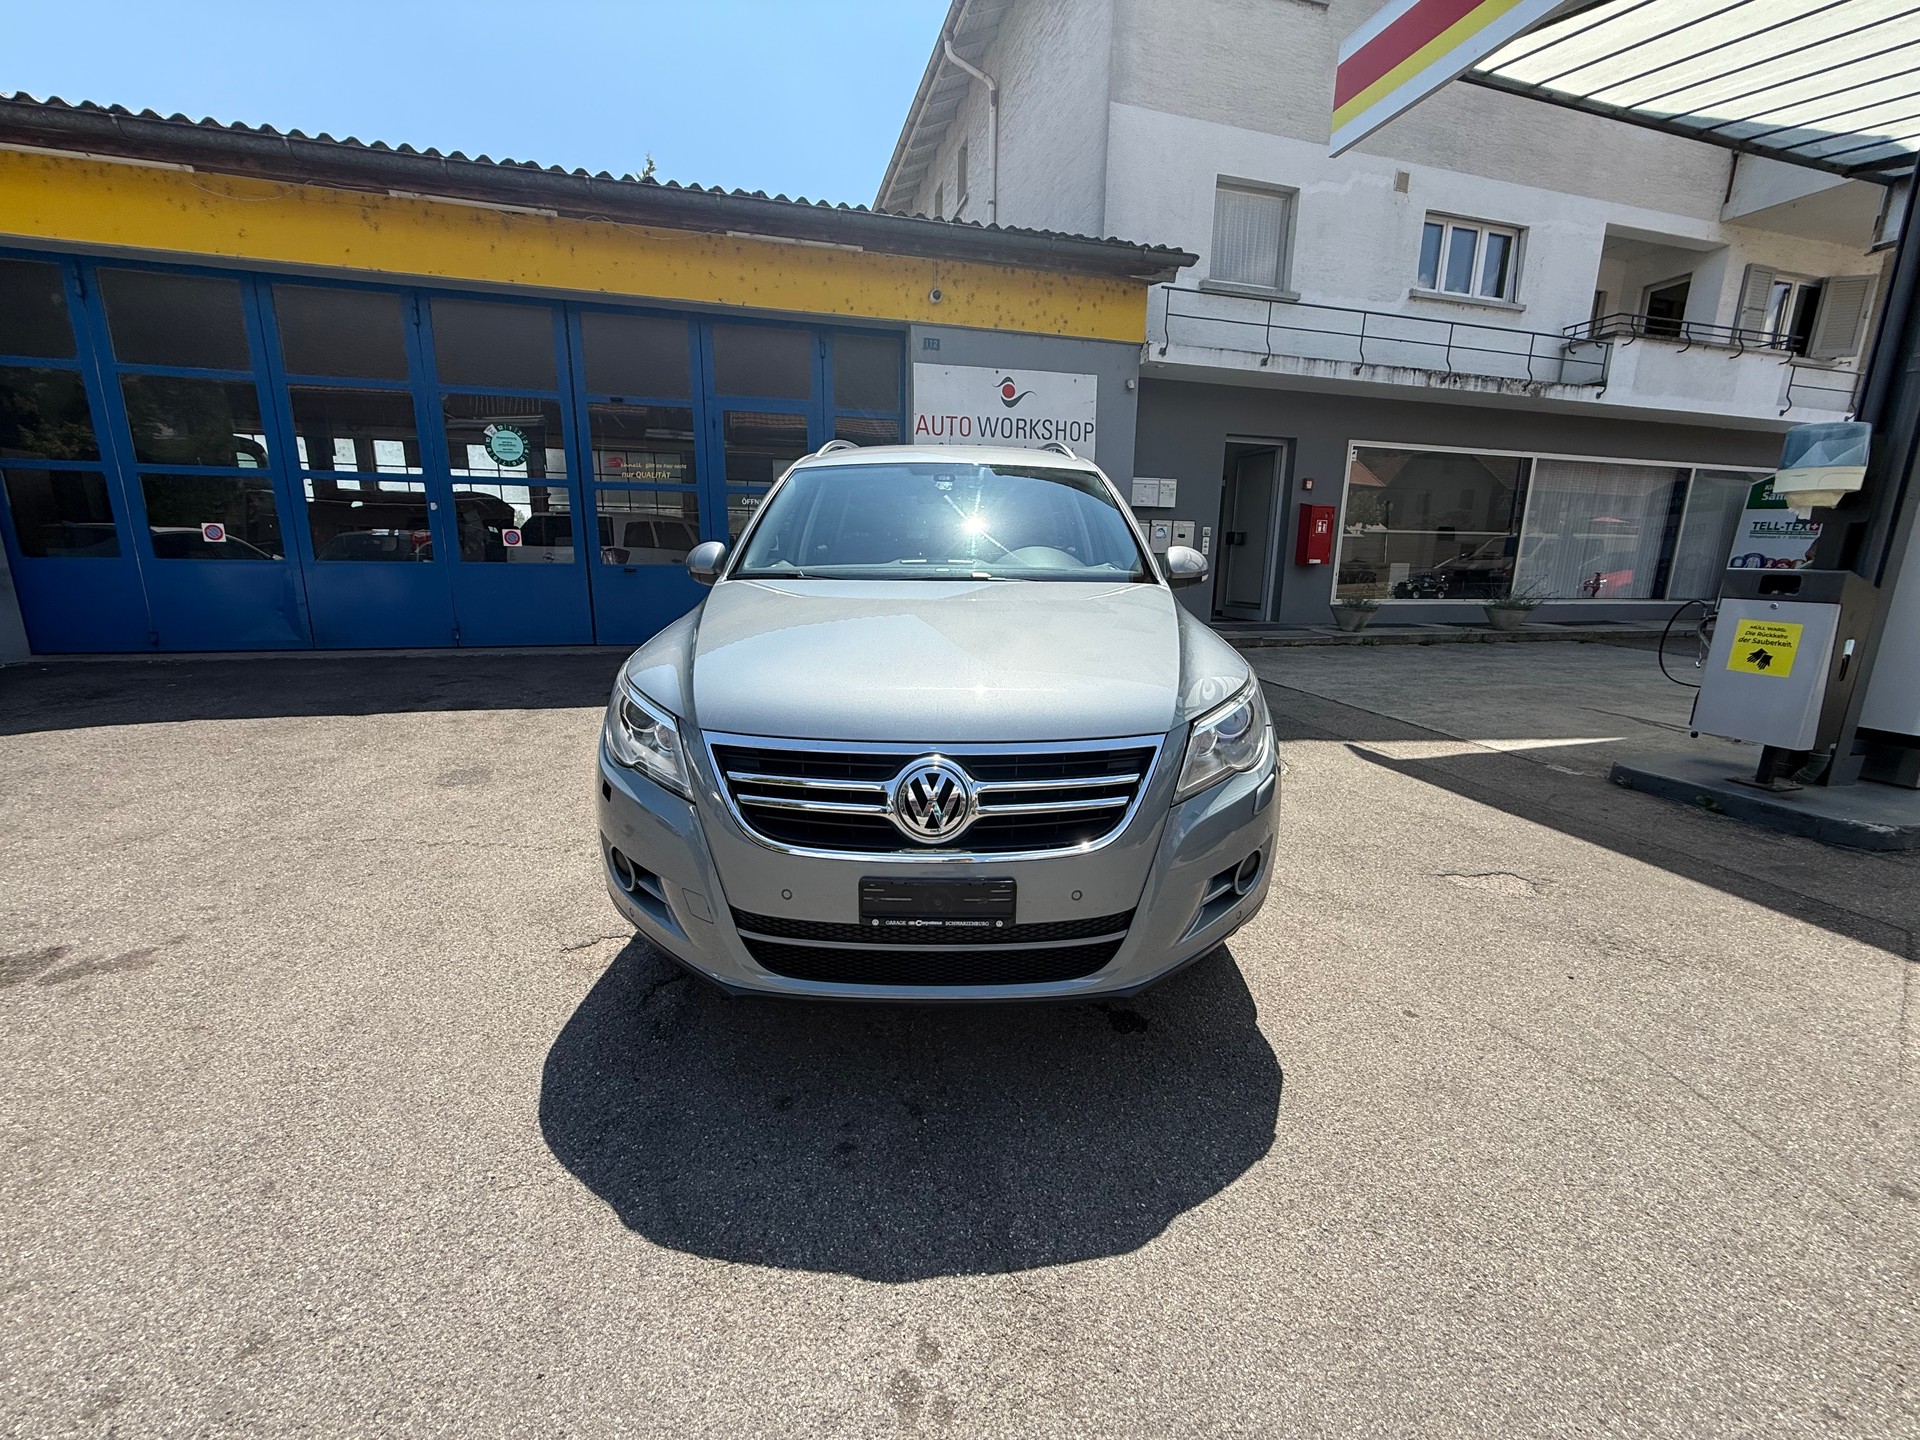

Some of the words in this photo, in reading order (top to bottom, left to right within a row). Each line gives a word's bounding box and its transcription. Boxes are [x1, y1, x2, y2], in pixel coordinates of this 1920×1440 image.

[915, 414, 972, 437] AUTO
[977, 416, 1095, 443] WORKSHOP
[635, 470, 671, 479] QUALITÄT
[1752, 521, 1808, 531] TELL-TEX
[1756, 631, 1789, 639] Rückkehr
